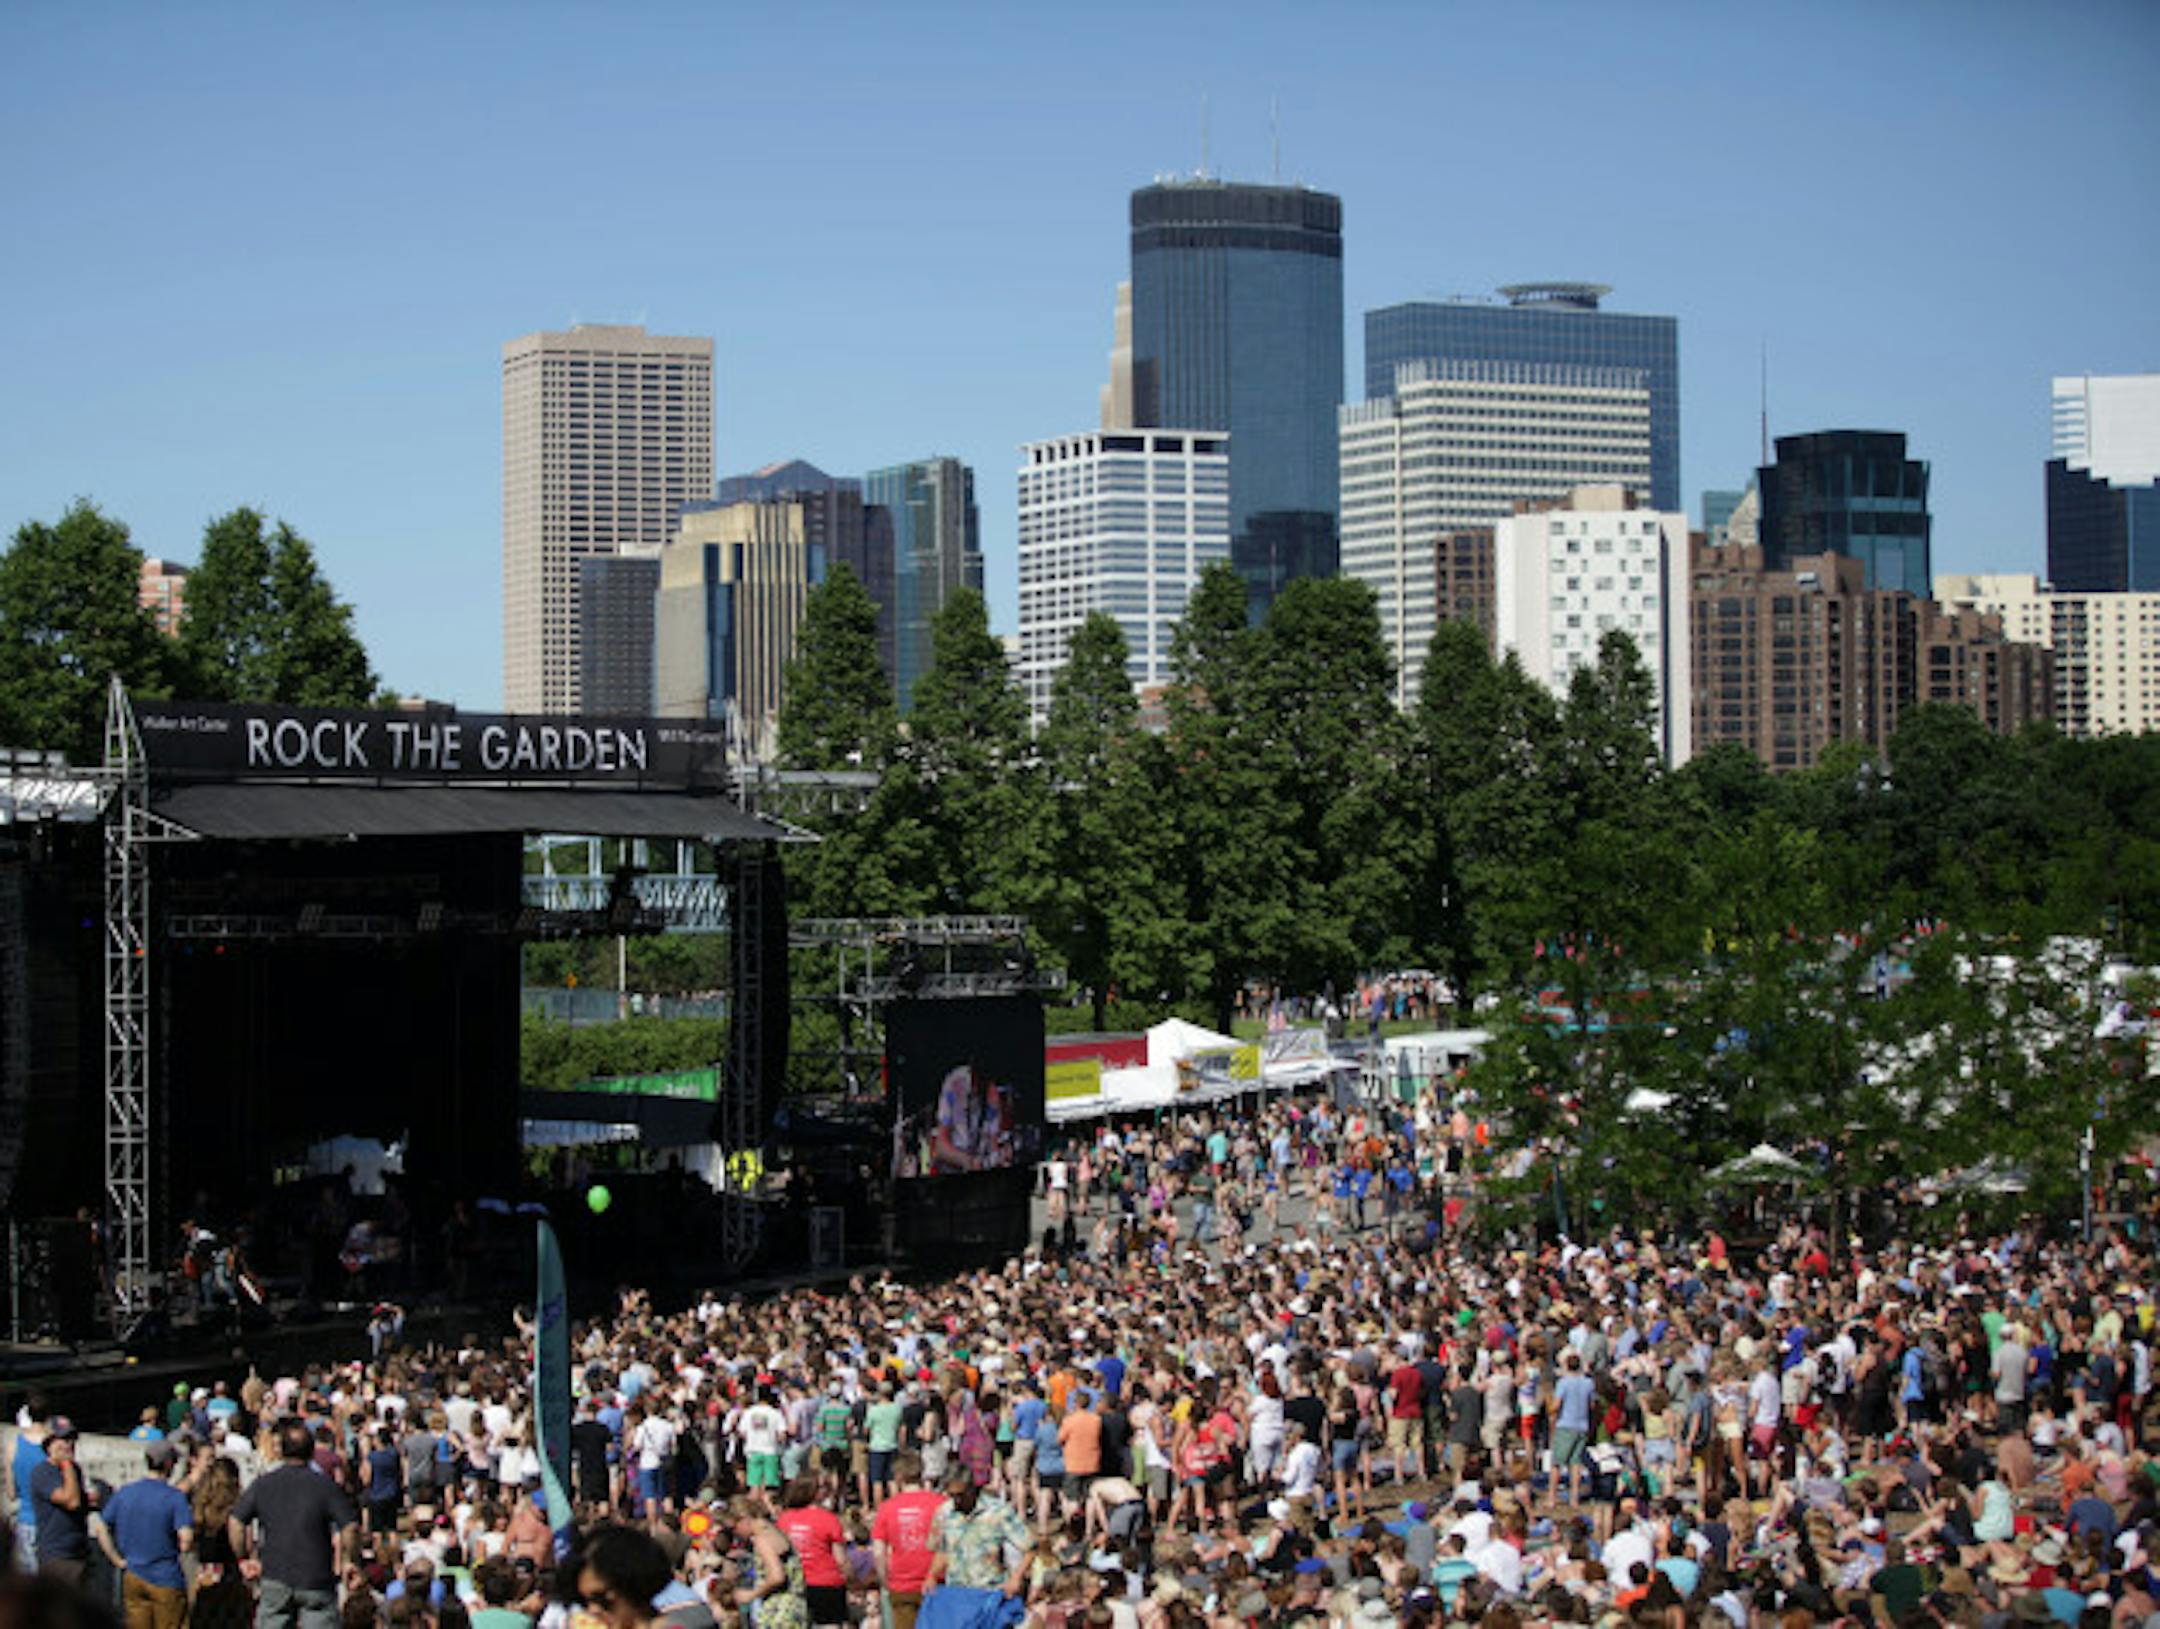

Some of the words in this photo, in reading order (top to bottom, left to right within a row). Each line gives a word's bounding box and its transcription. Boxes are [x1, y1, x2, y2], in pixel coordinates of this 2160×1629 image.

[246, 718, 369, 767] ROCK
[386, 722, 461, 770] THE
[481, 725, 647, 771] GARDEN
